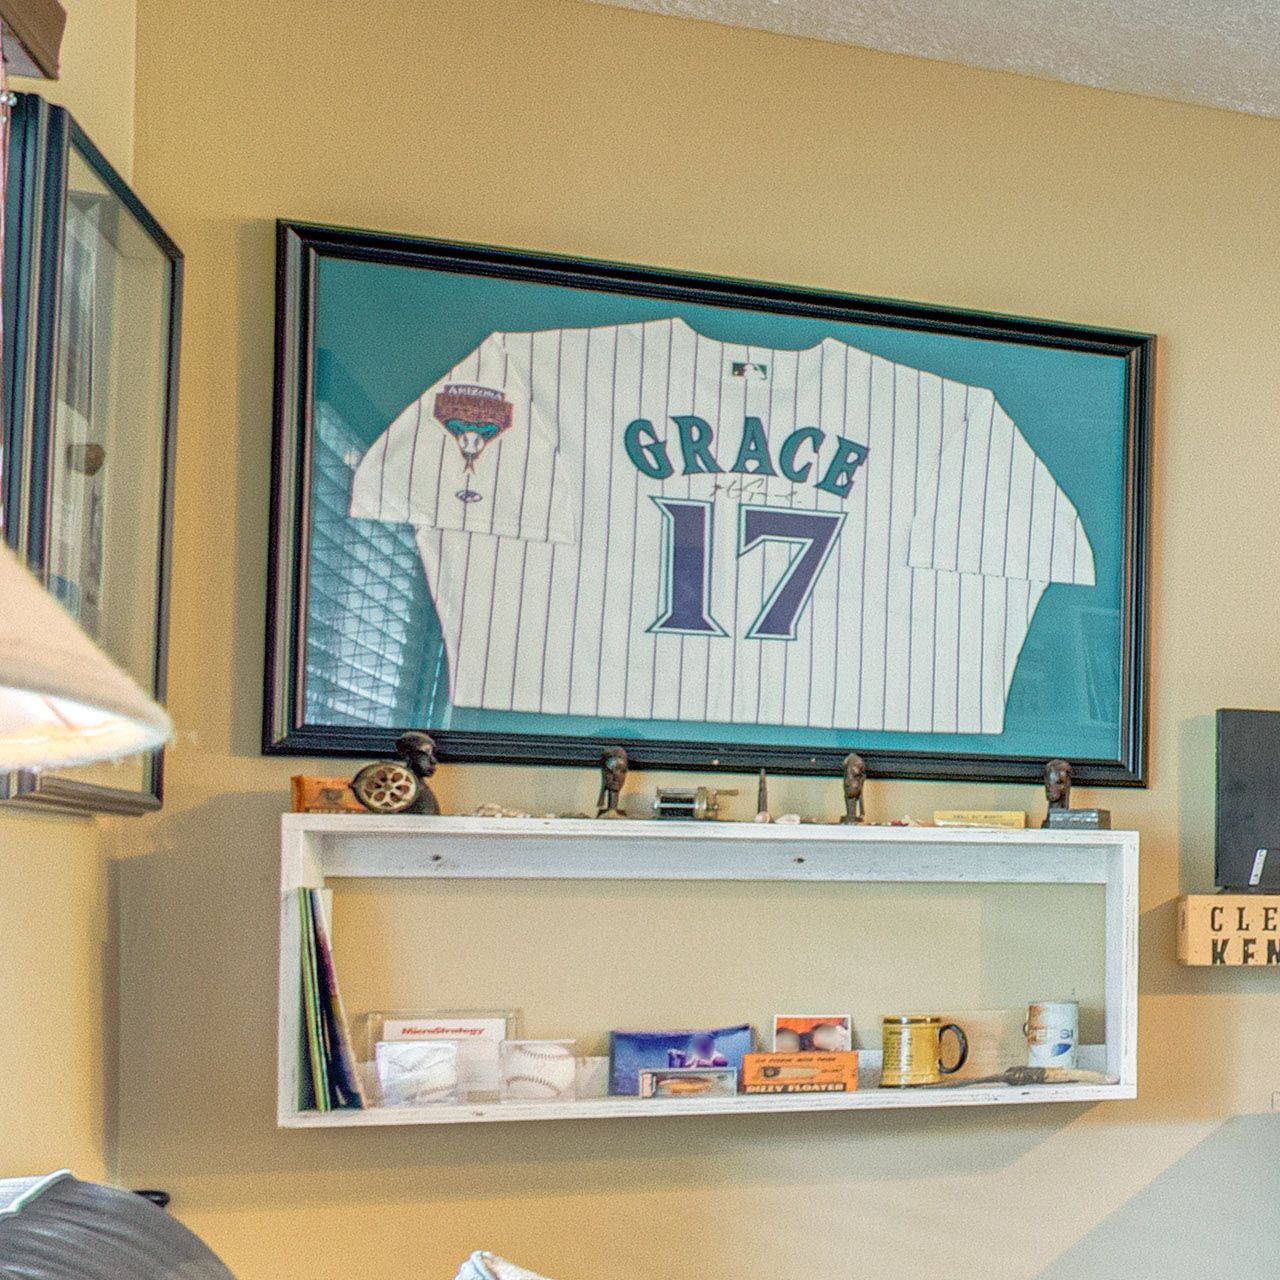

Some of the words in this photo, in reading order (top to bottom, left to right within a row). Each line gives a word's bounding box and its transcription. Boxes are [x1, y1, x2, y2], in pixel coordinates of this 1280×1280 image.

[624, 415, 871, 499] GRACE
[644, 495, 849, 641] 17
[401, 1026, 485, 1036] MicroStrategy
[746, 1084, 785, 1093] DIZZY
[787, 1083, 845, 1092] FLOATER
